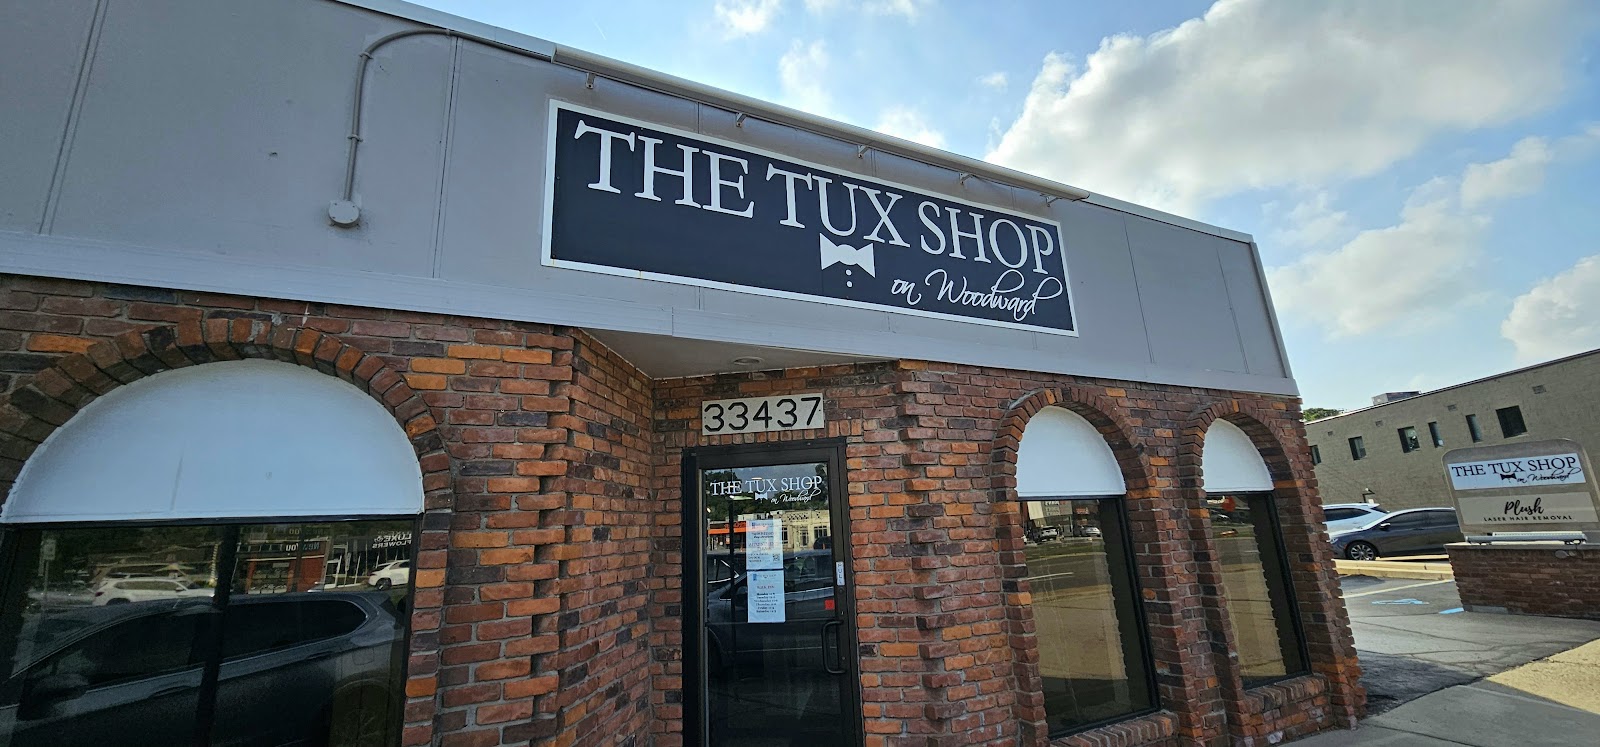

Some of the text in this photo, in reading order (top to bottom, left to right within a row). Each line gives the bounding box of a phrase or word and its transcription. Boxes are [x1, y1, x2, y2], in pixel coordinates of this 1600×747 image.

[574, 119, 1054, 274] THE TUX SHOP
[891, 268, 1063, 321] on Woodward
[704, 397, 821, 432] 33437
[1452, 457, 1576, 477] THE TUX SHOP
[710, 476, 822, 496] THE TUX SHOP
[1504, 497, 1544, 516] Plush
